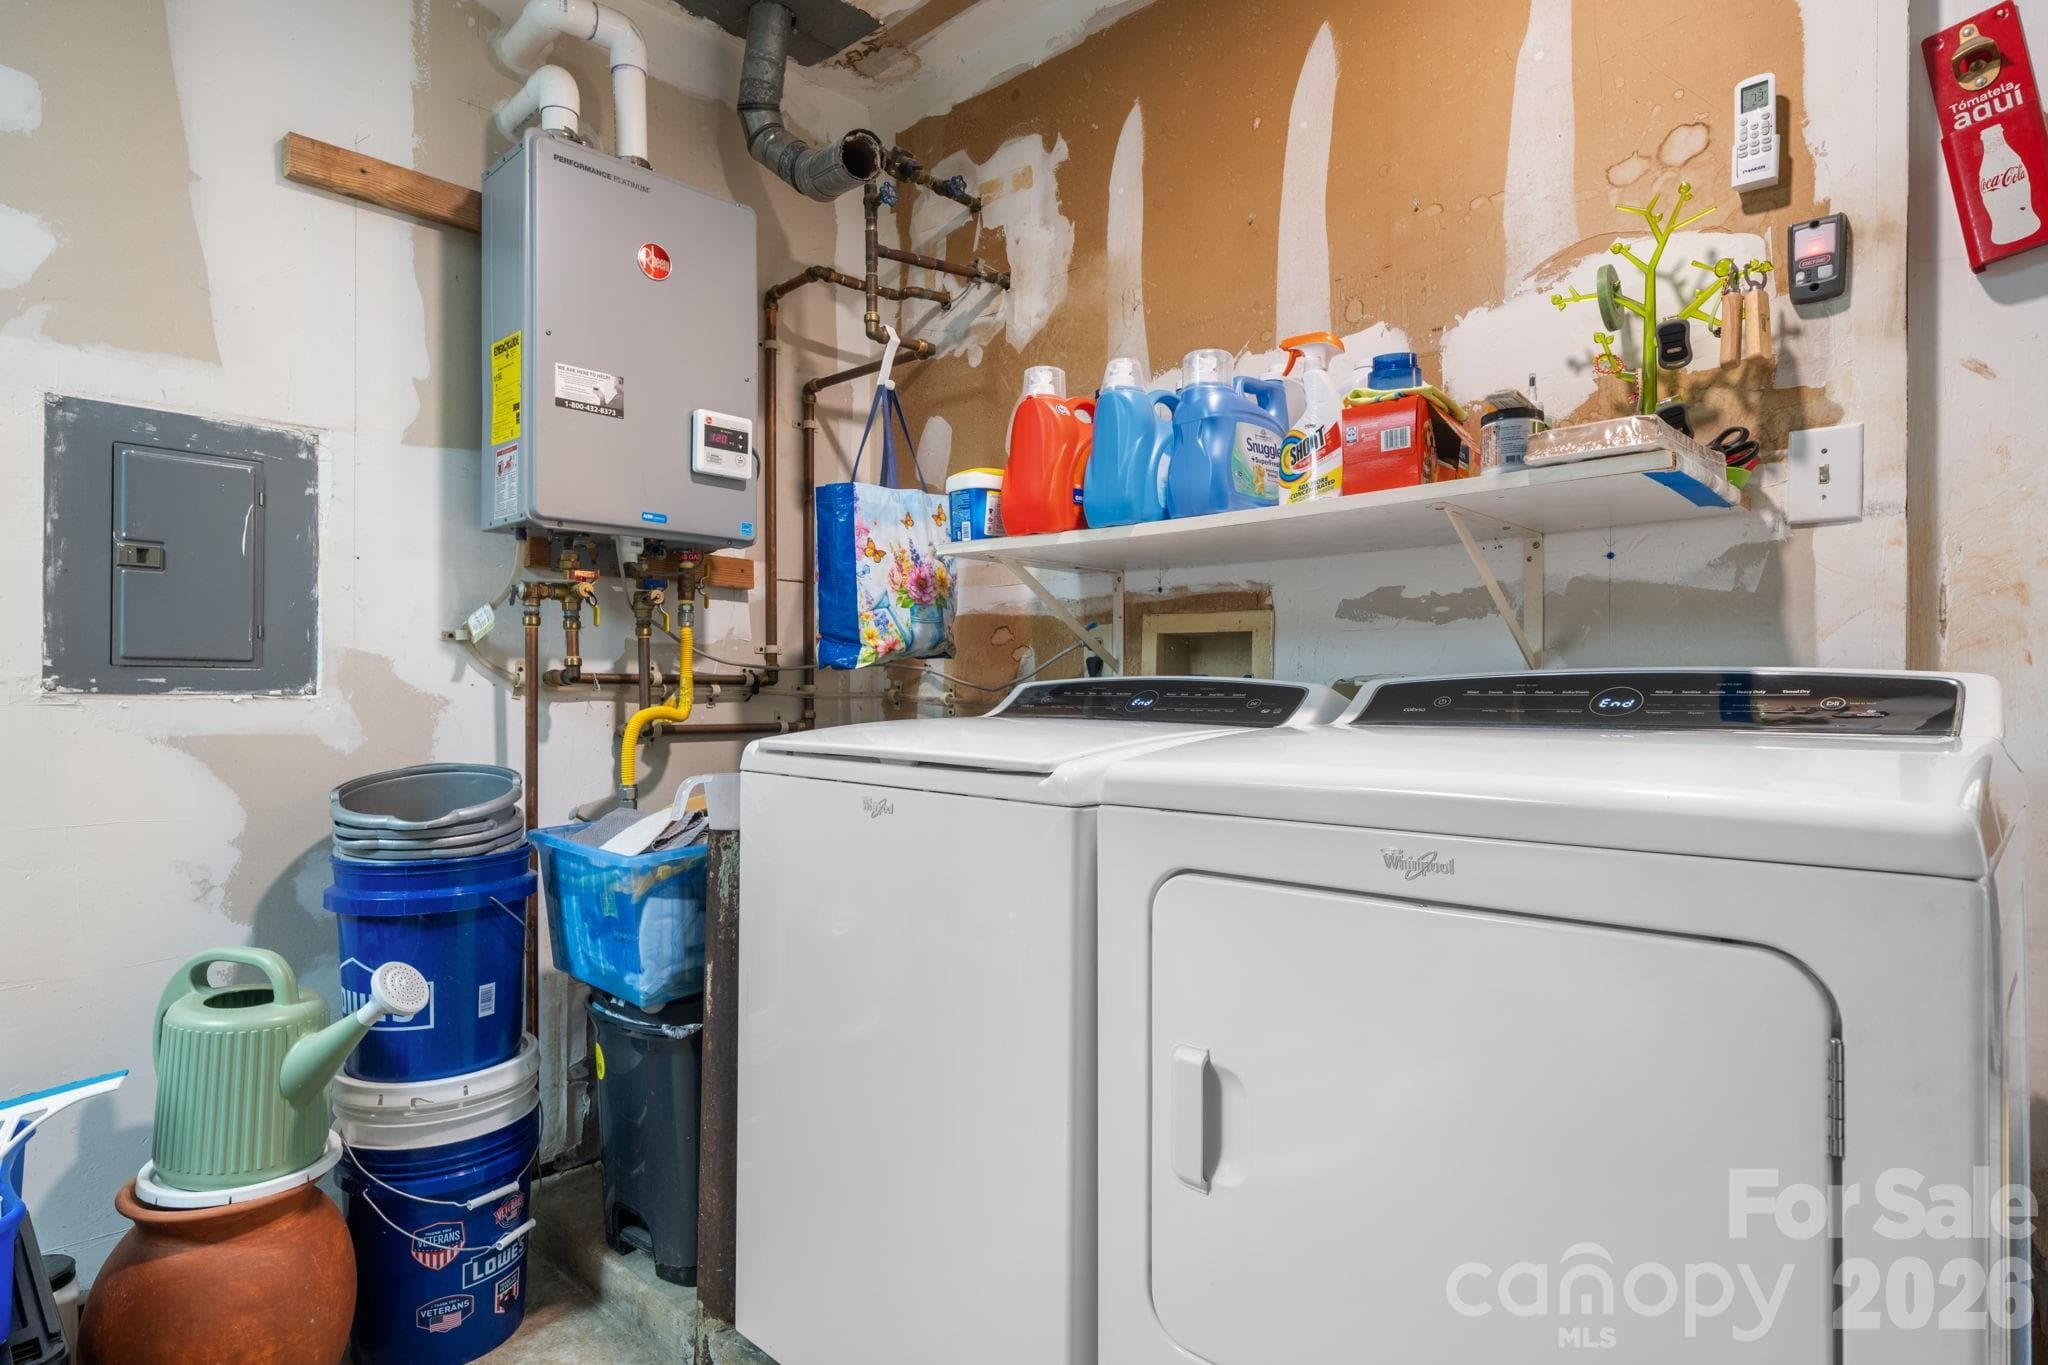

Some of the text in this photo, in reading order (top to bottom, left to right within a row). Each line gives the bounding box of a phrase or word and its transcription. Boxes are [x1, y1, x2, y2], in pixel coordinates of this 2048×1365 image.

[1949, 82, 2014, 115] Tómatela
[553, 153, 650, 194] PERFORMANCE PLATINUM
[565, 400, 617, 417] 1-800-432-8373
[710, 432, 728, 444] 120
[1246, 437, 1281, 460] Snuggle
[1290, 425, 1325, 466] SHOUT
[1598, 698, 1634, 708] End
[1382, 849, 1455, 881] Whirlpool
[417, 1230, 461, 1248] VETERANS
[420, 1299, 470, 1318] VETERANS
